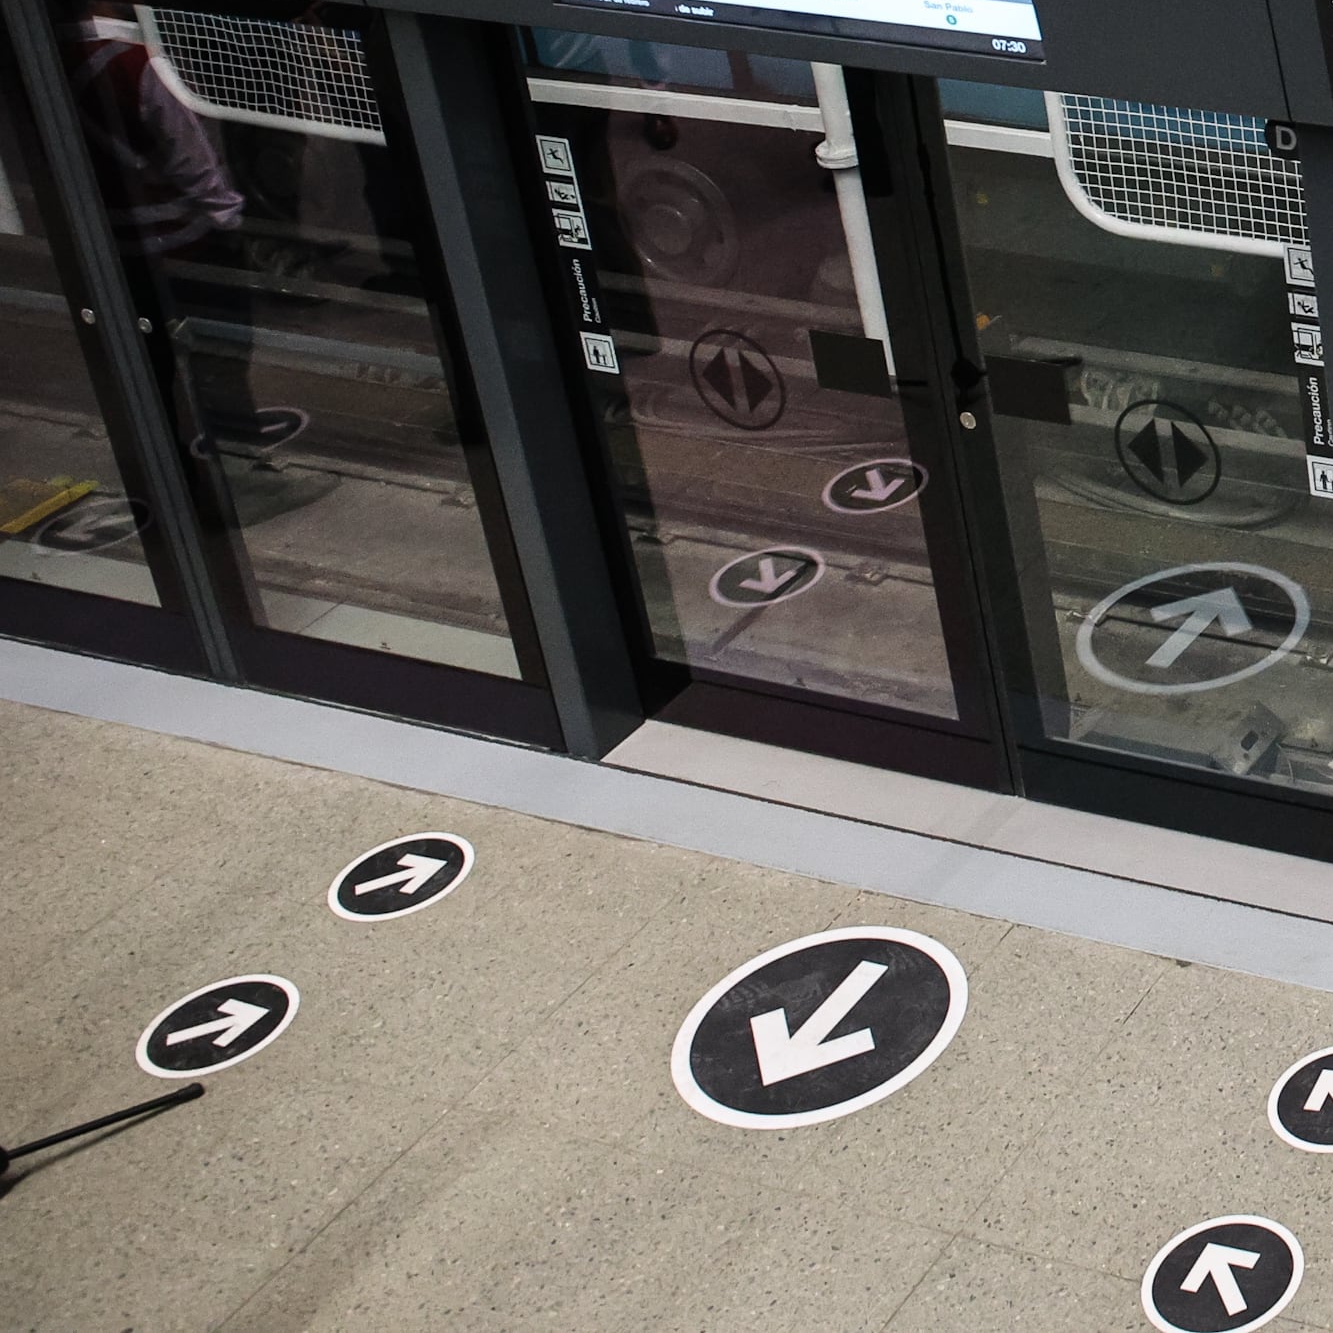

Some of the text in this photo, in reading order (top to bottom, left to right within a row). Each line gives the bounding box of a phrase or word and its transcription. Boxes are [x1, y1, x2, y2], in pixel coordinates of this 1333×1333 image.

[678, 4, 714, 17] de subir
[923, 0, 974, 14] San Pablo
[992, 38, 1027, 54] 07:30
[1275, 125, 1297, 151] D
[572, 258, 593, 323] Precaución
[1306, 377, 1325, 446] Precaución
